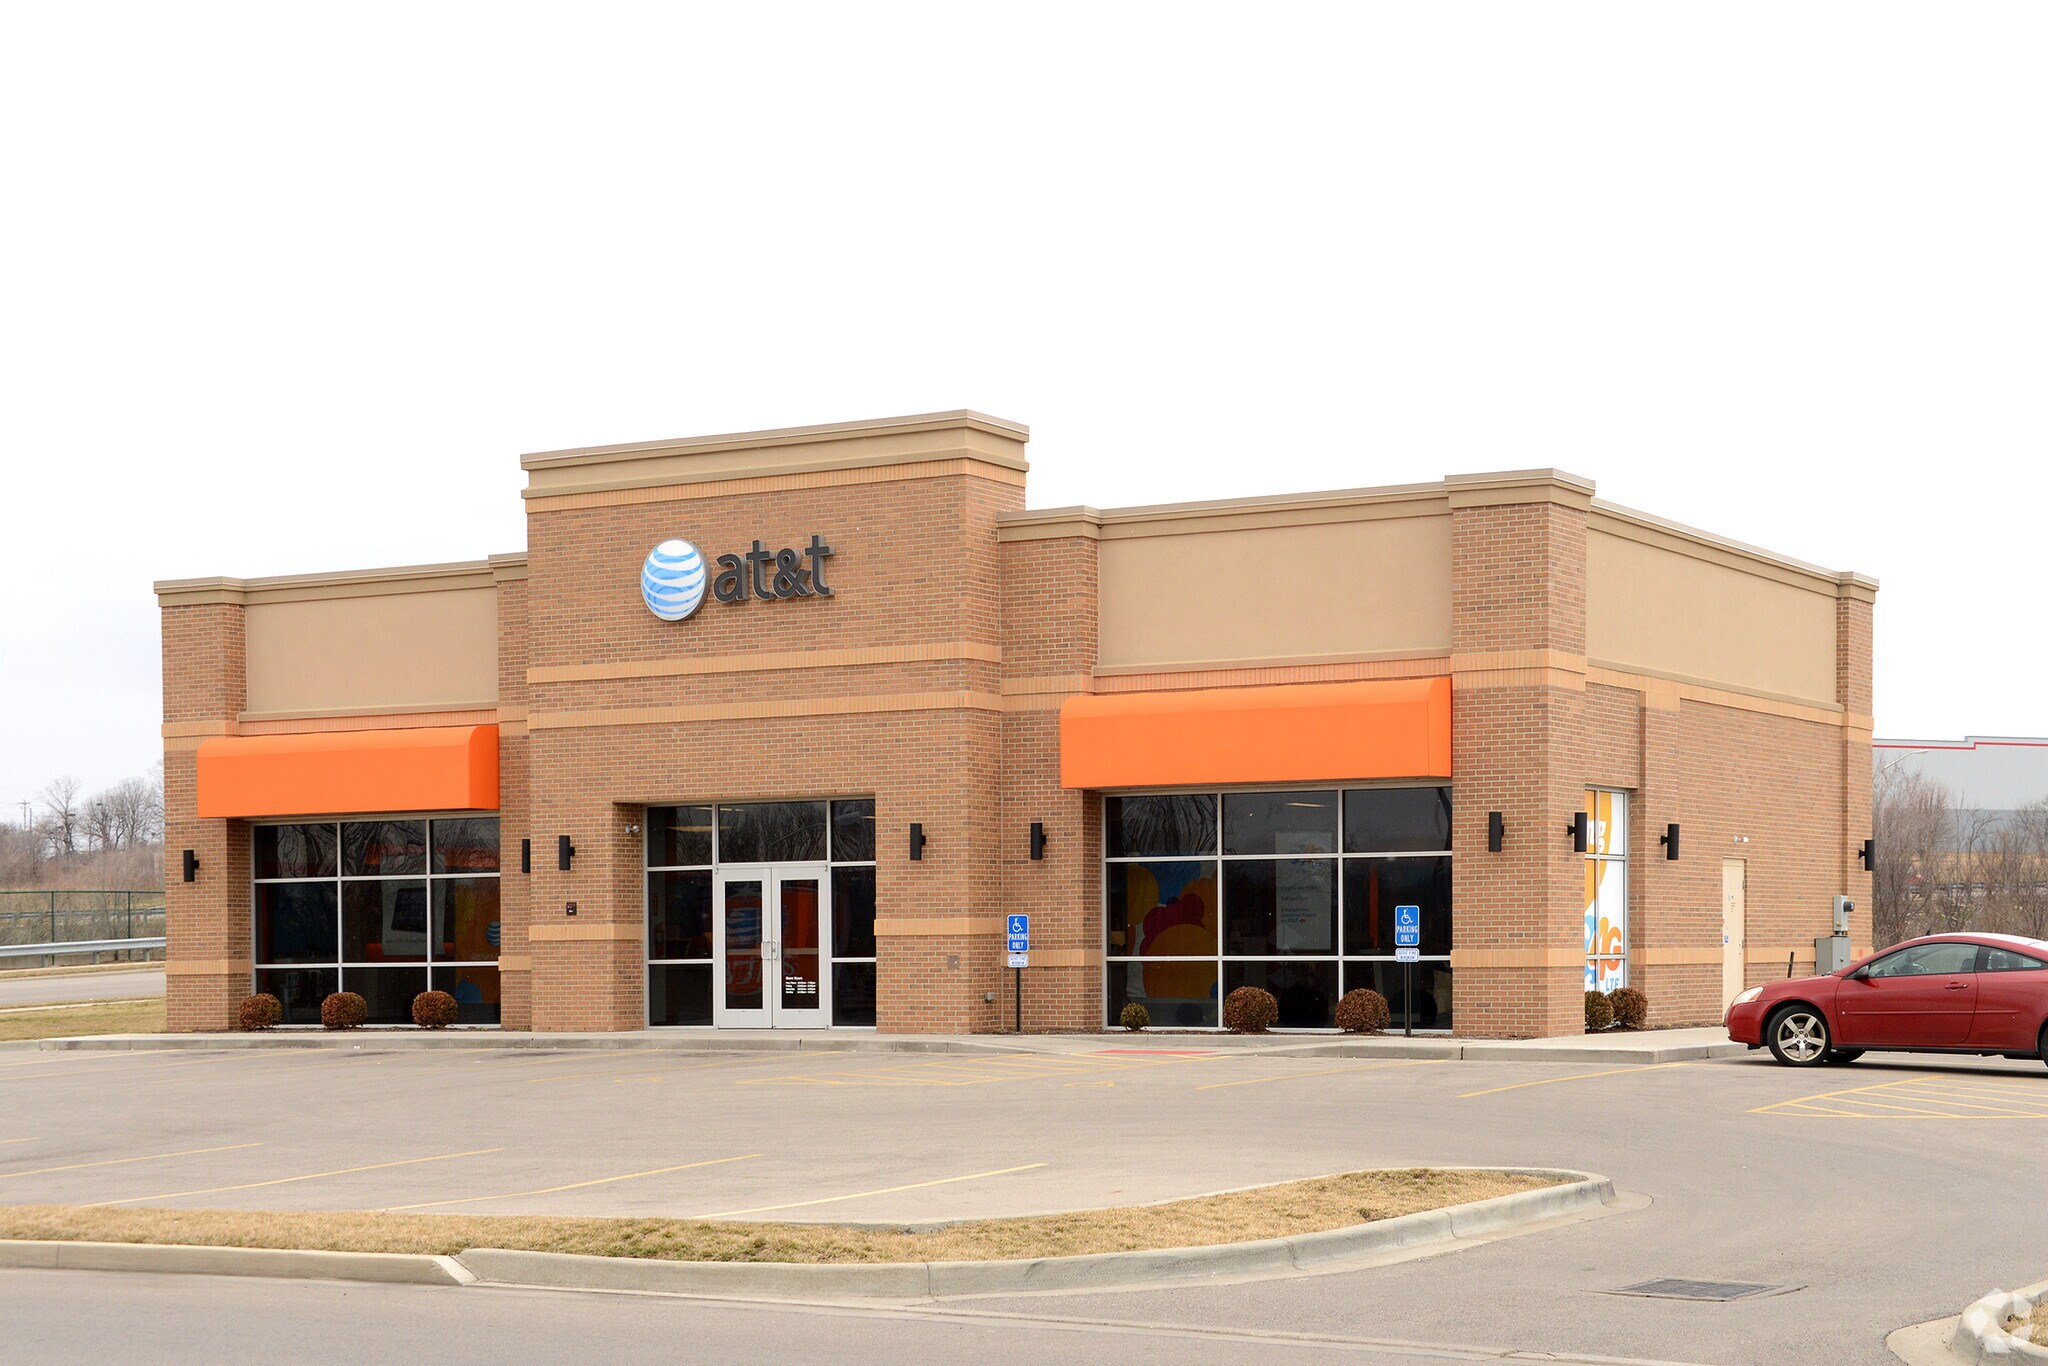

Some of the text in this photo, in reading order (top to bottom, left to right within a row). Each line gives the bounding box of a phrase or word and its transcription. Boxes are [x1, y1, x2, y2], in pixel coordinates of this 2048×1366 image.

[713, 535, 834, 604] at&t
[1396, 925, 1418, 933] PARKING
[1009, 933, 1027, 941] PARKING
[1400, 934, 1414, 943] ONLY
[1012, 941, 1024, 950] ONLY
[1605, 977, 1620, 992] LTE
